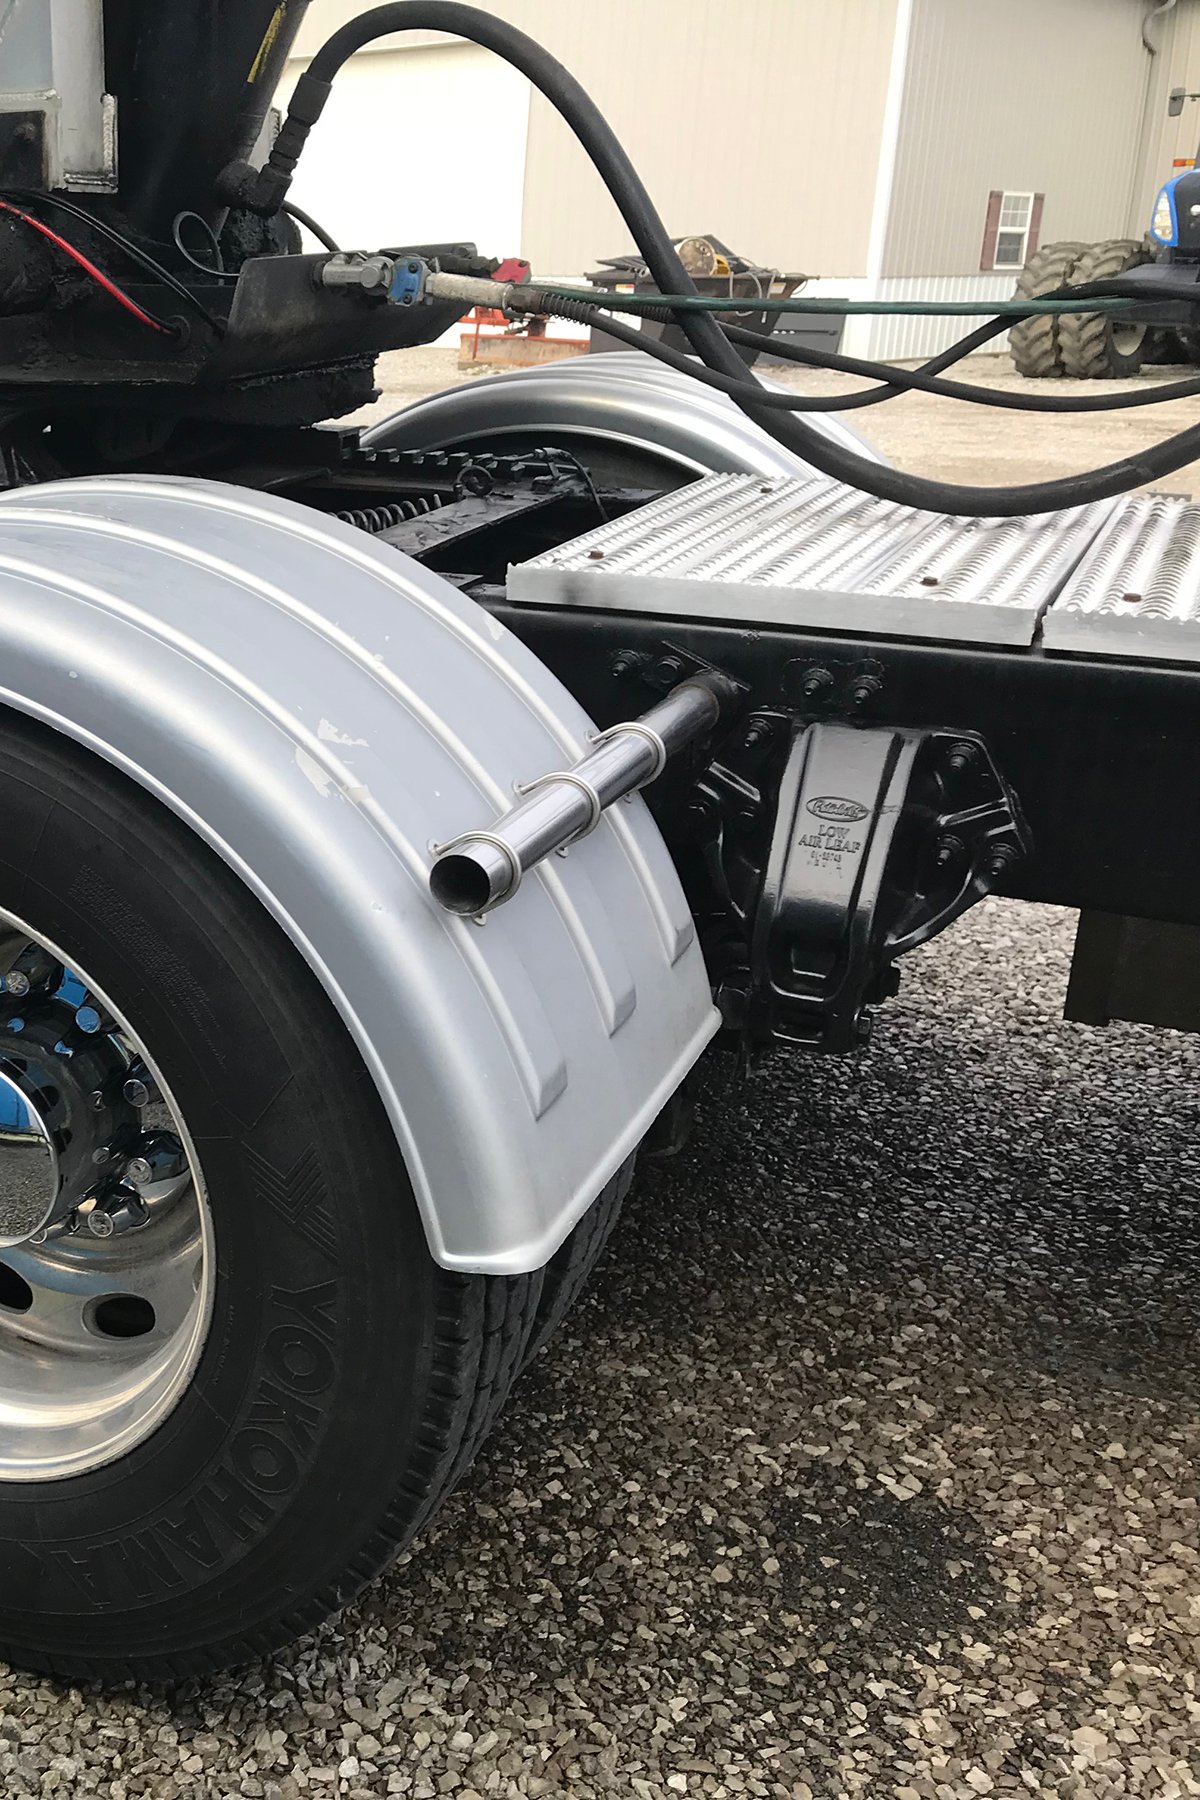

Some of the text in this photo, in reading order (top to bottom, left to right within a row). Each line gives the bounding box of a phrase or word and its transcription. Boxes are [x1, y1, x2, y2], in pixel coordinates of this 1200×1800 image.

[818, 824, 850, 839] LOW
[798, 834, 861, 854] AIR LEAF
[50, 1281, 338, 1605] YOKOHAMA
